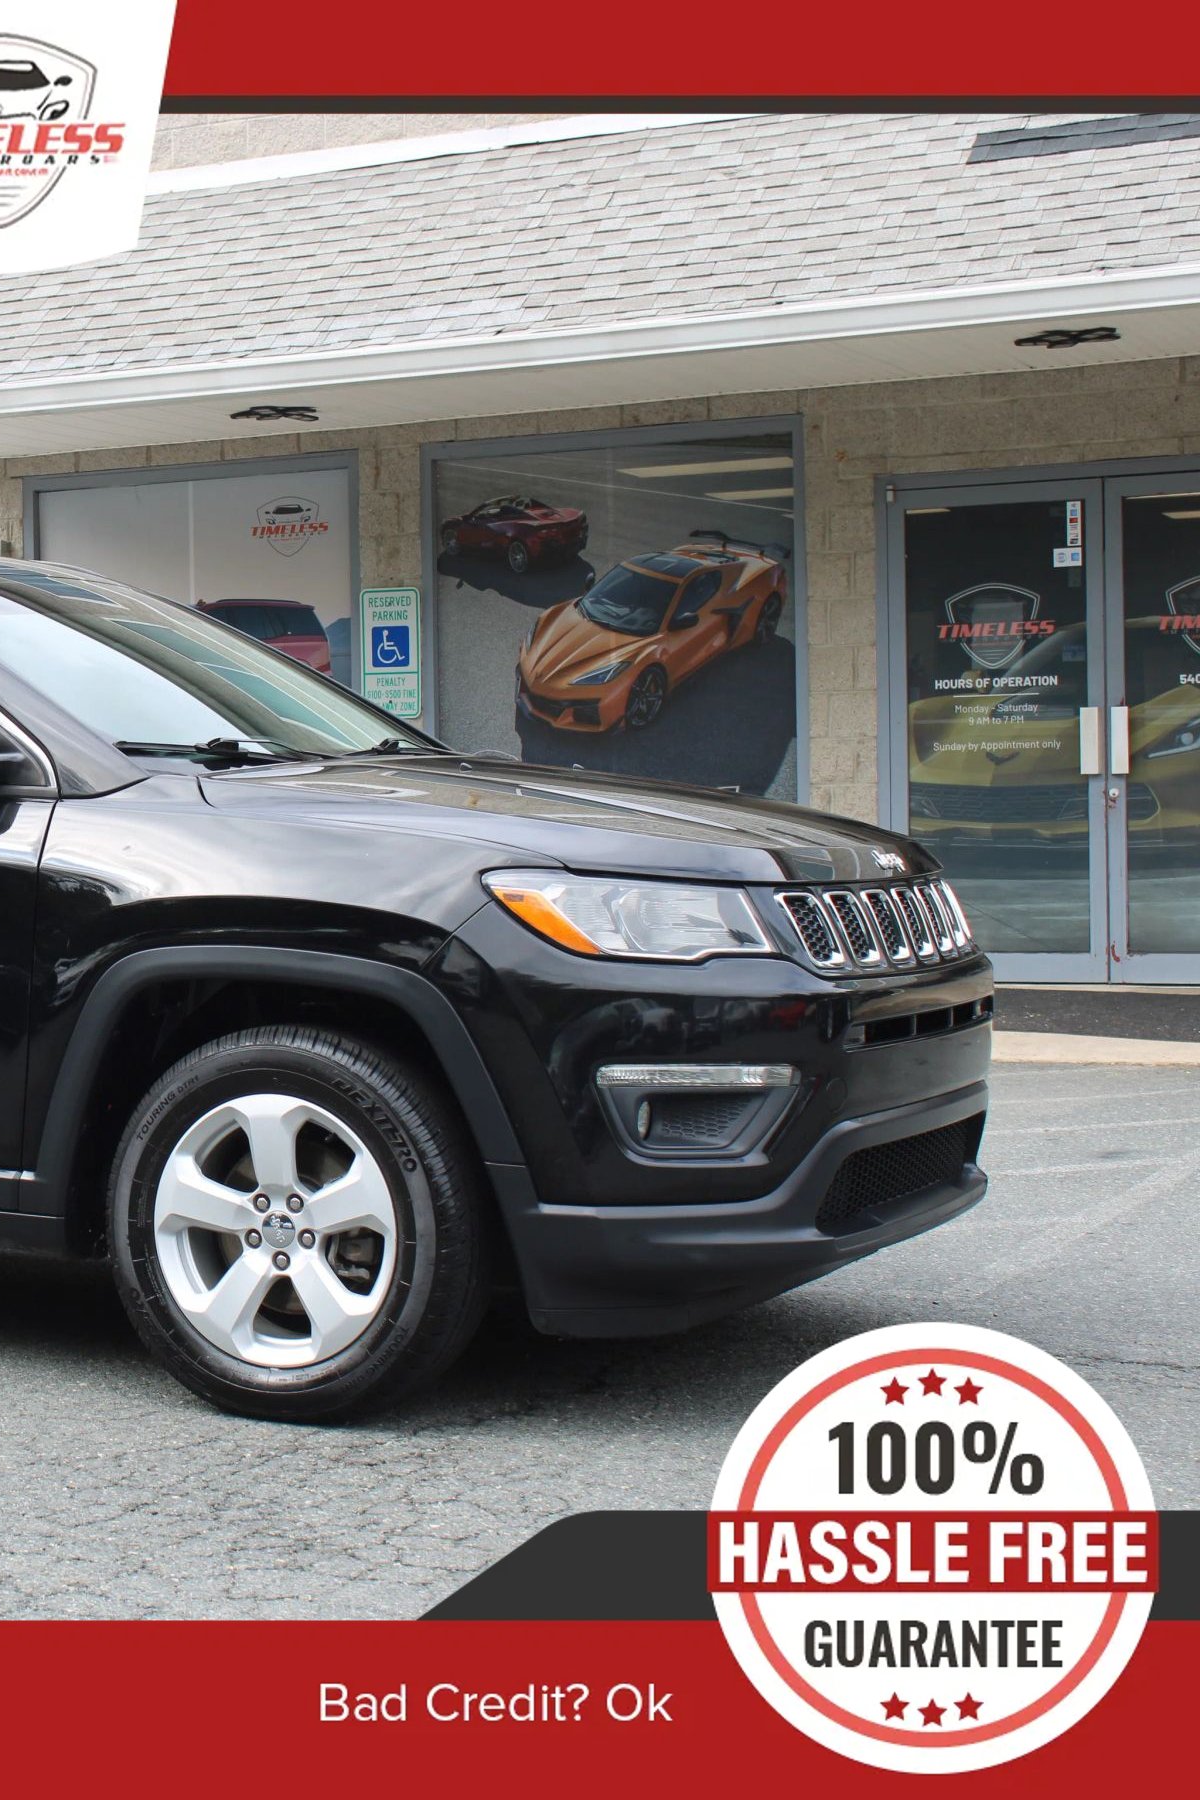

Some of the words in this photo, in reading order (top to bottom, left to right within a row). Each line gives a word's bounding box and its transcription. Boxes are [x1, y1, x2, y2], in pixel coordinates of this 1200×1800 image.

[250, 521, 329, 537] TIMELESS
[368, 596, 412, 608] RESERVED
[372, 610, 408, 621] PARKING
[936, 620, 1057, 639] TIMELESS
[376, 677, 406, 687] PENALTY
[935, 679, 973, 690] HOURS
[975, 678, 991, 688] OF
[993, 675, 1058, 688] OPERATION
[954, 705, 990, 715] Monday
[997, 703, 1039, 714] Saturday
[968, 717, 974, 726] 9
[976, 716, 990, 725] AM
[992, 716, 1002, 725] to
[1010, 714, 1025, 724] PM
[933, 743, 967, 753] Sunday
[968, 742, 979, 752] by
[980, 740, 1040, 751] Appointment
[1041, 739, 1062, 750] only
[136, 1090, 177, 1141] TOURING
